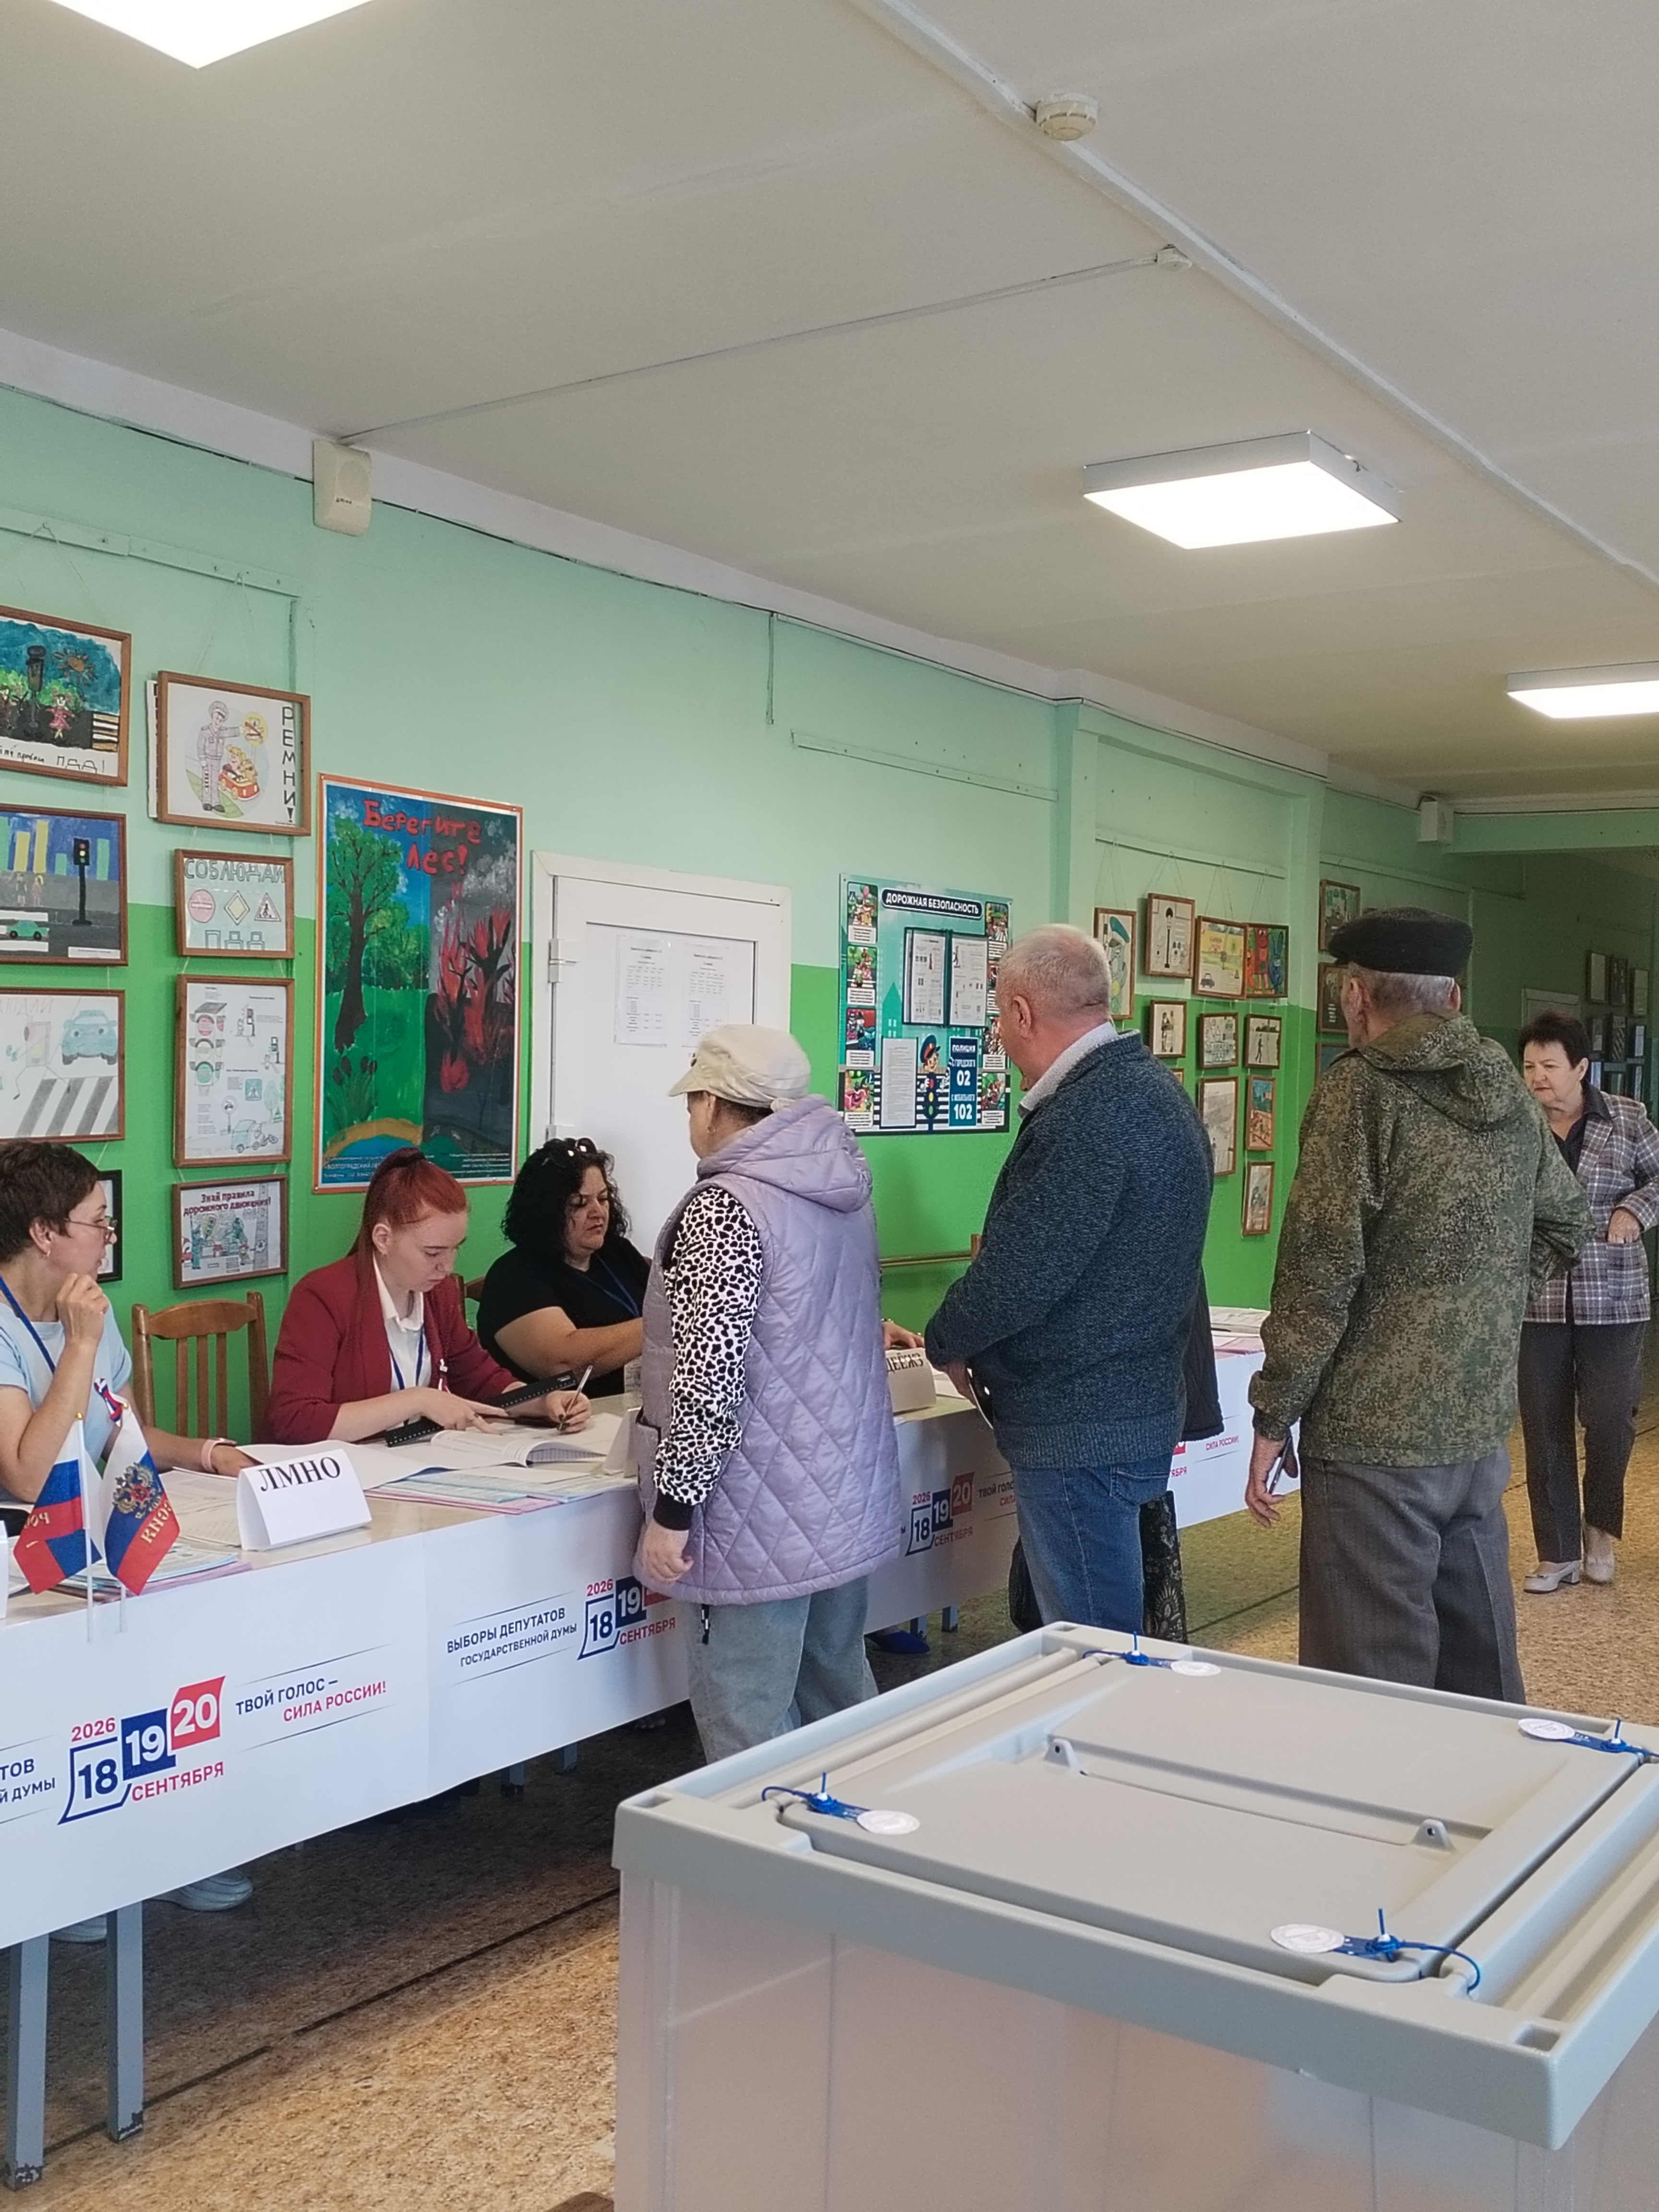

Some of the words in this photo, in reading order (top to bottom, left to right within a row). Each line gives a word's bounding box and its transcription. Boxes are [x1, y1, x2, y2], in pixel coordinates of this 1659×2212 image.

[282, 706, 296, 823] РЕМНИ!
[886, 892, 927, 907] ДОРОЖНАЯ
[928, 898, 979, 914] БЕЗОПАСНОСТЬ
[204, 929, 265, 950] ПДД
[957, 1070, 971, 1086] 02
[954, 1103, 973, 1120] 102
[201, 1191, 220, 1203] Знай
[222, 1190, 254, 1202] правила
[257, 1455, 341, 1492] ЛМНО
[912, 1491, 931, 1505] 2026
[978, 1483, 997, 1498] ТВОЙ
[914, 1519, 930, 1542] 18
[933, 1499, 950, 1524] 19
[953, 1481, 971, 1508] 20
[934, 1526, 974, 1547] СЕНТЯБРЯ
[586, 1578, 614, 1597] 2026
[589, 1610, 613, 1642] 18
[618, 1586, 641, 1618] 19
[447, 1626, 497, 1654] ВЫБОРЫ
[499, 1607, 565, 1638] ДЕПУТАТОВ
[619, 1617, 676, 1646] СЕНТЯБРЯ
[460, 1628, 550, 1667] ГОСУДАРСТВЕННОЙ
[551, 1623, 577, 1641] ДУМЫ
[235, 1690, 274, 1716] ТВОЙ
[277, 1678, 325, 1703] ГОЛОС
[283, 1701, 322, 1722] СИЛА
[325, 1681, 386, 1710] РОССИИ!
[71, 1717, 116, 1742] 2026
[78, 1759, 119, 1800] 18
[125, 1724, 166, 1767] 19
[173, 1693, 218, 1737] 20
[11, 1777, 55, 1803] ДУМЫ
[131, 1761, 225, 1802] СЕНТЯБРЯ
